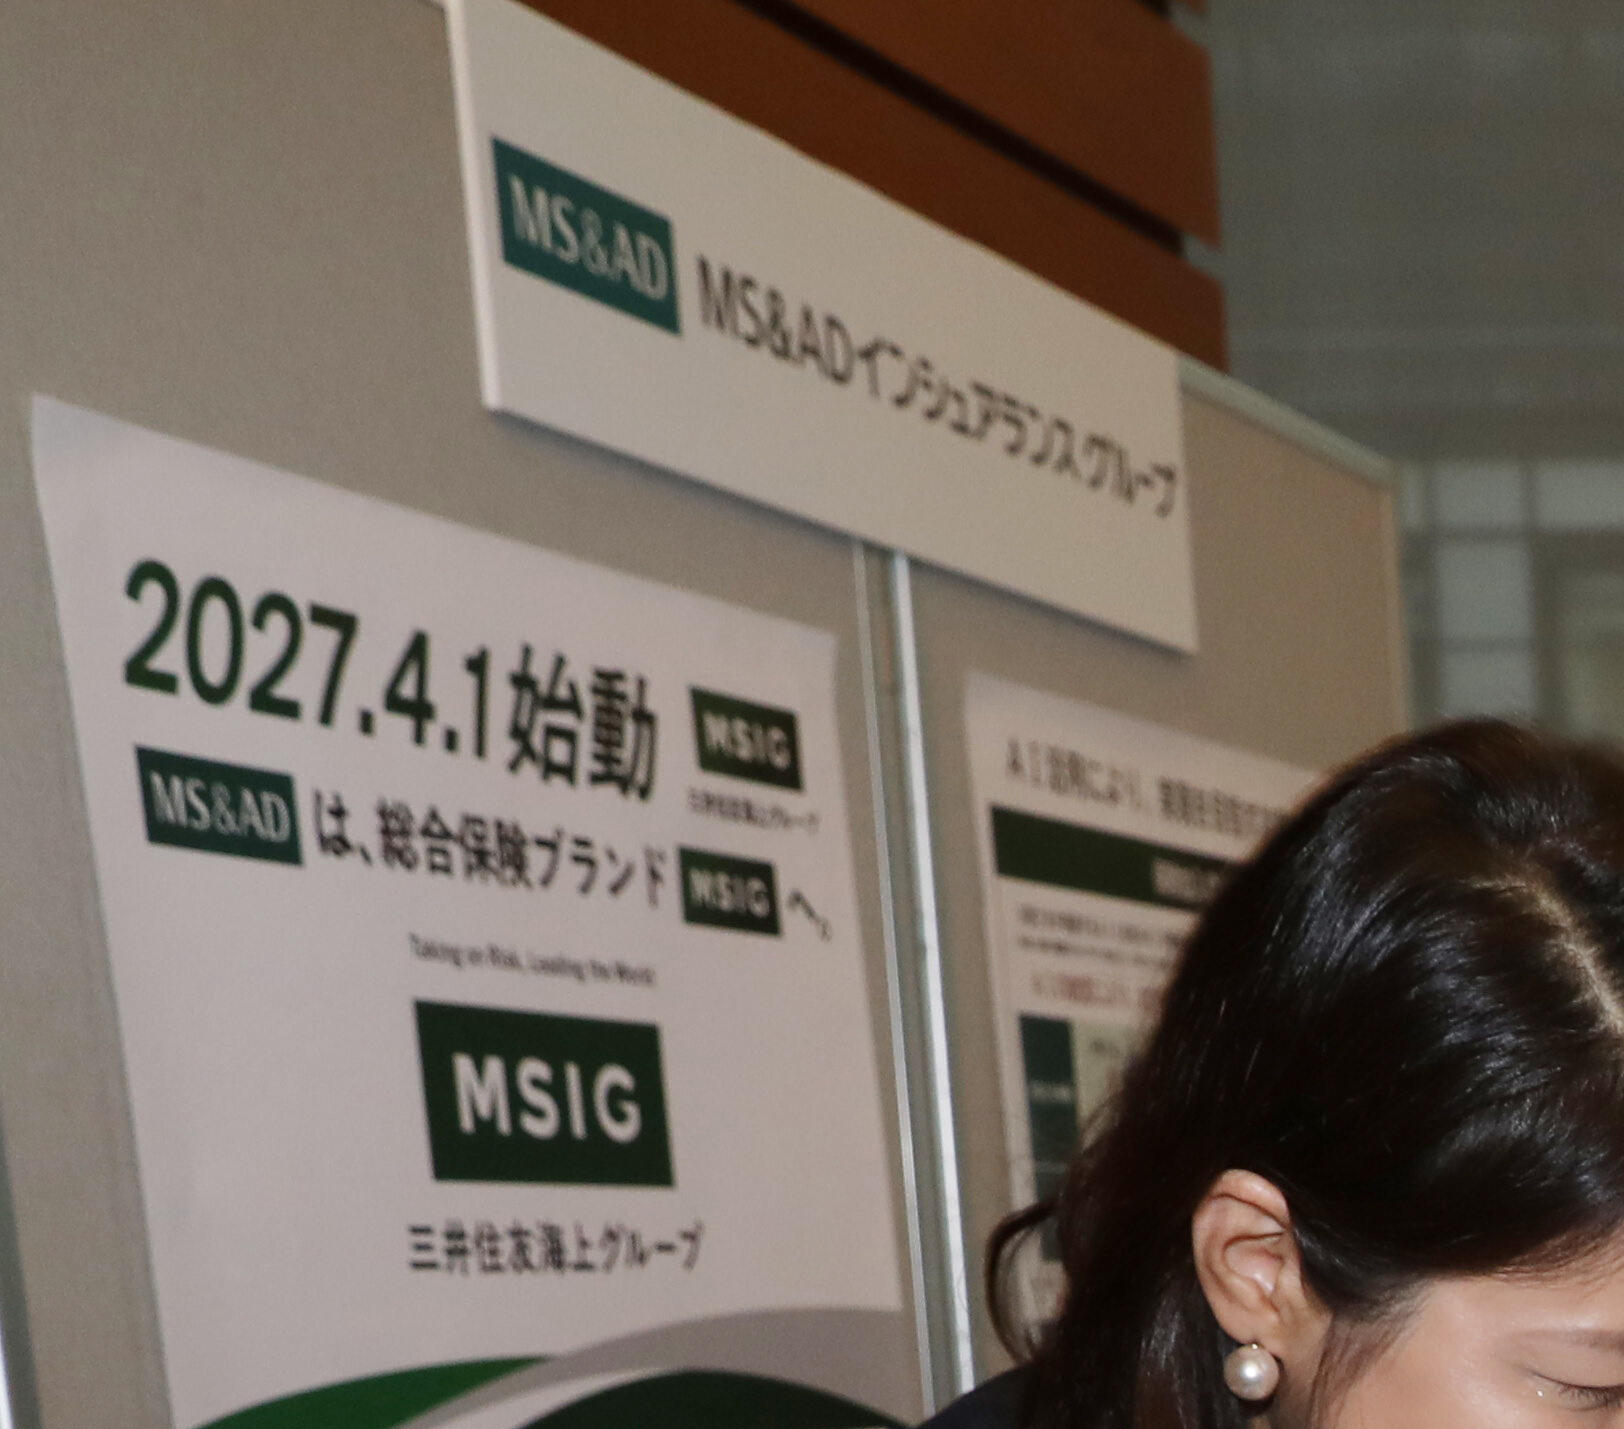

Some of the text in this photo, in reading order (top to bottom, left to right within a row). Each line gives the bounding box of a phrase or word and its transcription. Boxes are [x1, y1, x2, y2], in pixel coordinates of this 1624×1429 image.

[508, 175, 669, 301] MS&AD
[124, 559, 658, 801] 2027.4.1始動
[700, 711, 794, 770] MSIG
[149, 770, 291, 844] MS&AD
[452, 1052, 642, 1144] MSIG
[409, 1217, 705, 1274] 三井住友海上グループ
